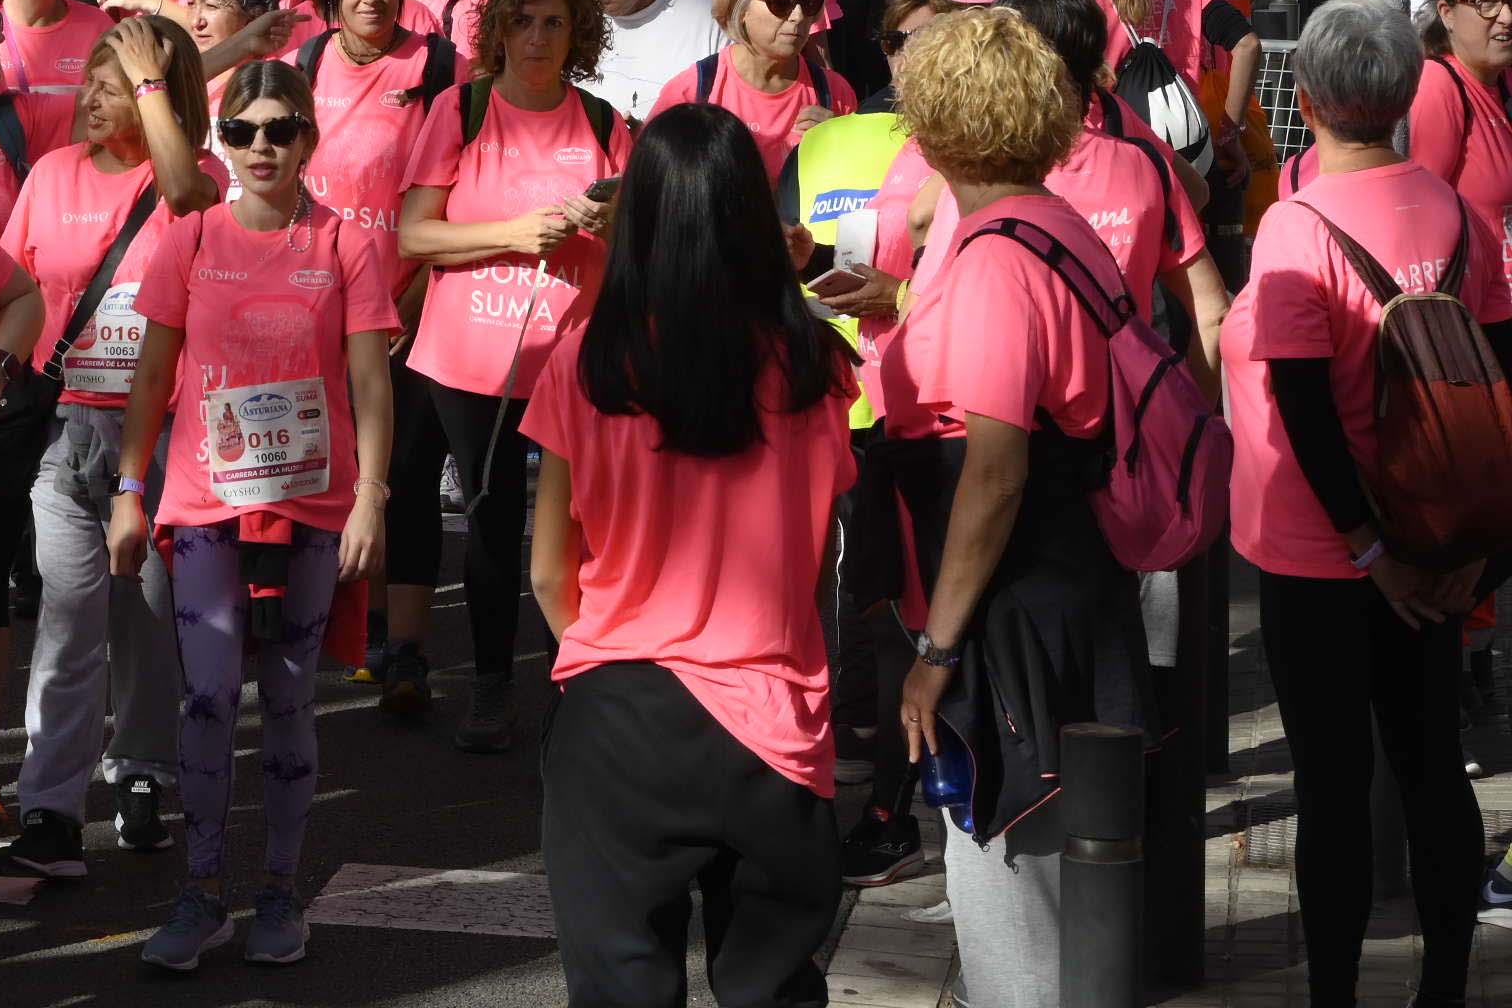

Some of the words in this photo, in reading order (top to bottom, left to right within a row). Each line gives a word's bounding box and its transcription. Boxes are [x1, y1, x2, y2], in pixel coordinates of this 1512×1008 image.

[62, 211, 110, 225] OYSHO
[198, 269, 248, 281] OYSHO
[471, 259, 586, 290] DORSAL
[102, 303, 135, 313] ASTURIA
[469, 289, 554, 323] SUMA
[100, 325, 141, 341] 016
[103, 346, 136, 356] 10063
[76, 359, 104, 369] CARRERA
[106, 359, 116, 369] DE
[118, 359, 127, 369] LA
[75, 374, 106, 385] OYSHO
[241, 402, 289, 417] ASTURIANA
[247, 429, 291, 449] 016
[254, 450, 288, 465] 10060
[225, 470, 259, 481] CARRERA
[259, 468, 270, 478] DE
[271, 467, 281, 476] LA
[223, 485, 261, 498] OYSHO
